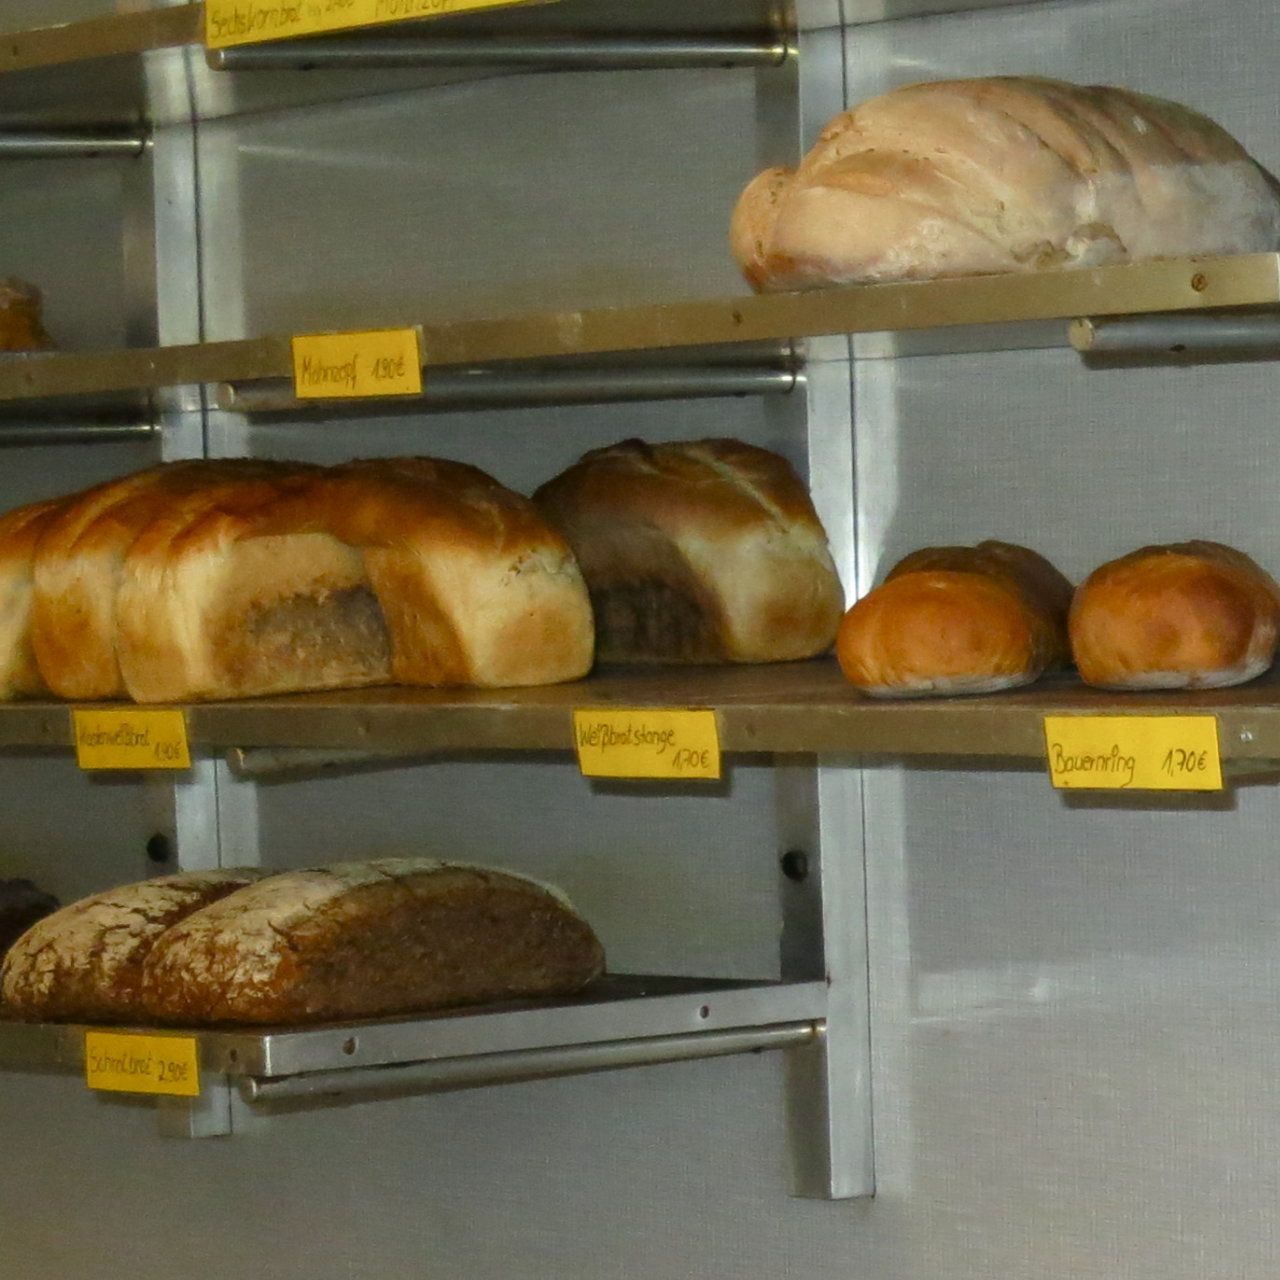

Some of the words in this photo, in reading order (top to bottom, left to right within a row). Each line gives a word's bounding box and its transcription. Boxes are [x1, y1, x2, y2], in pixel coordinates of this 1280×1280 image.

[580, 723, 675, 754] Weißbrotstange
[672, 749, 709, 770] 1,70€
[1051, 742, 1136, 788] Bauernring
[1161, 748, 1208, 776] 1,70€
